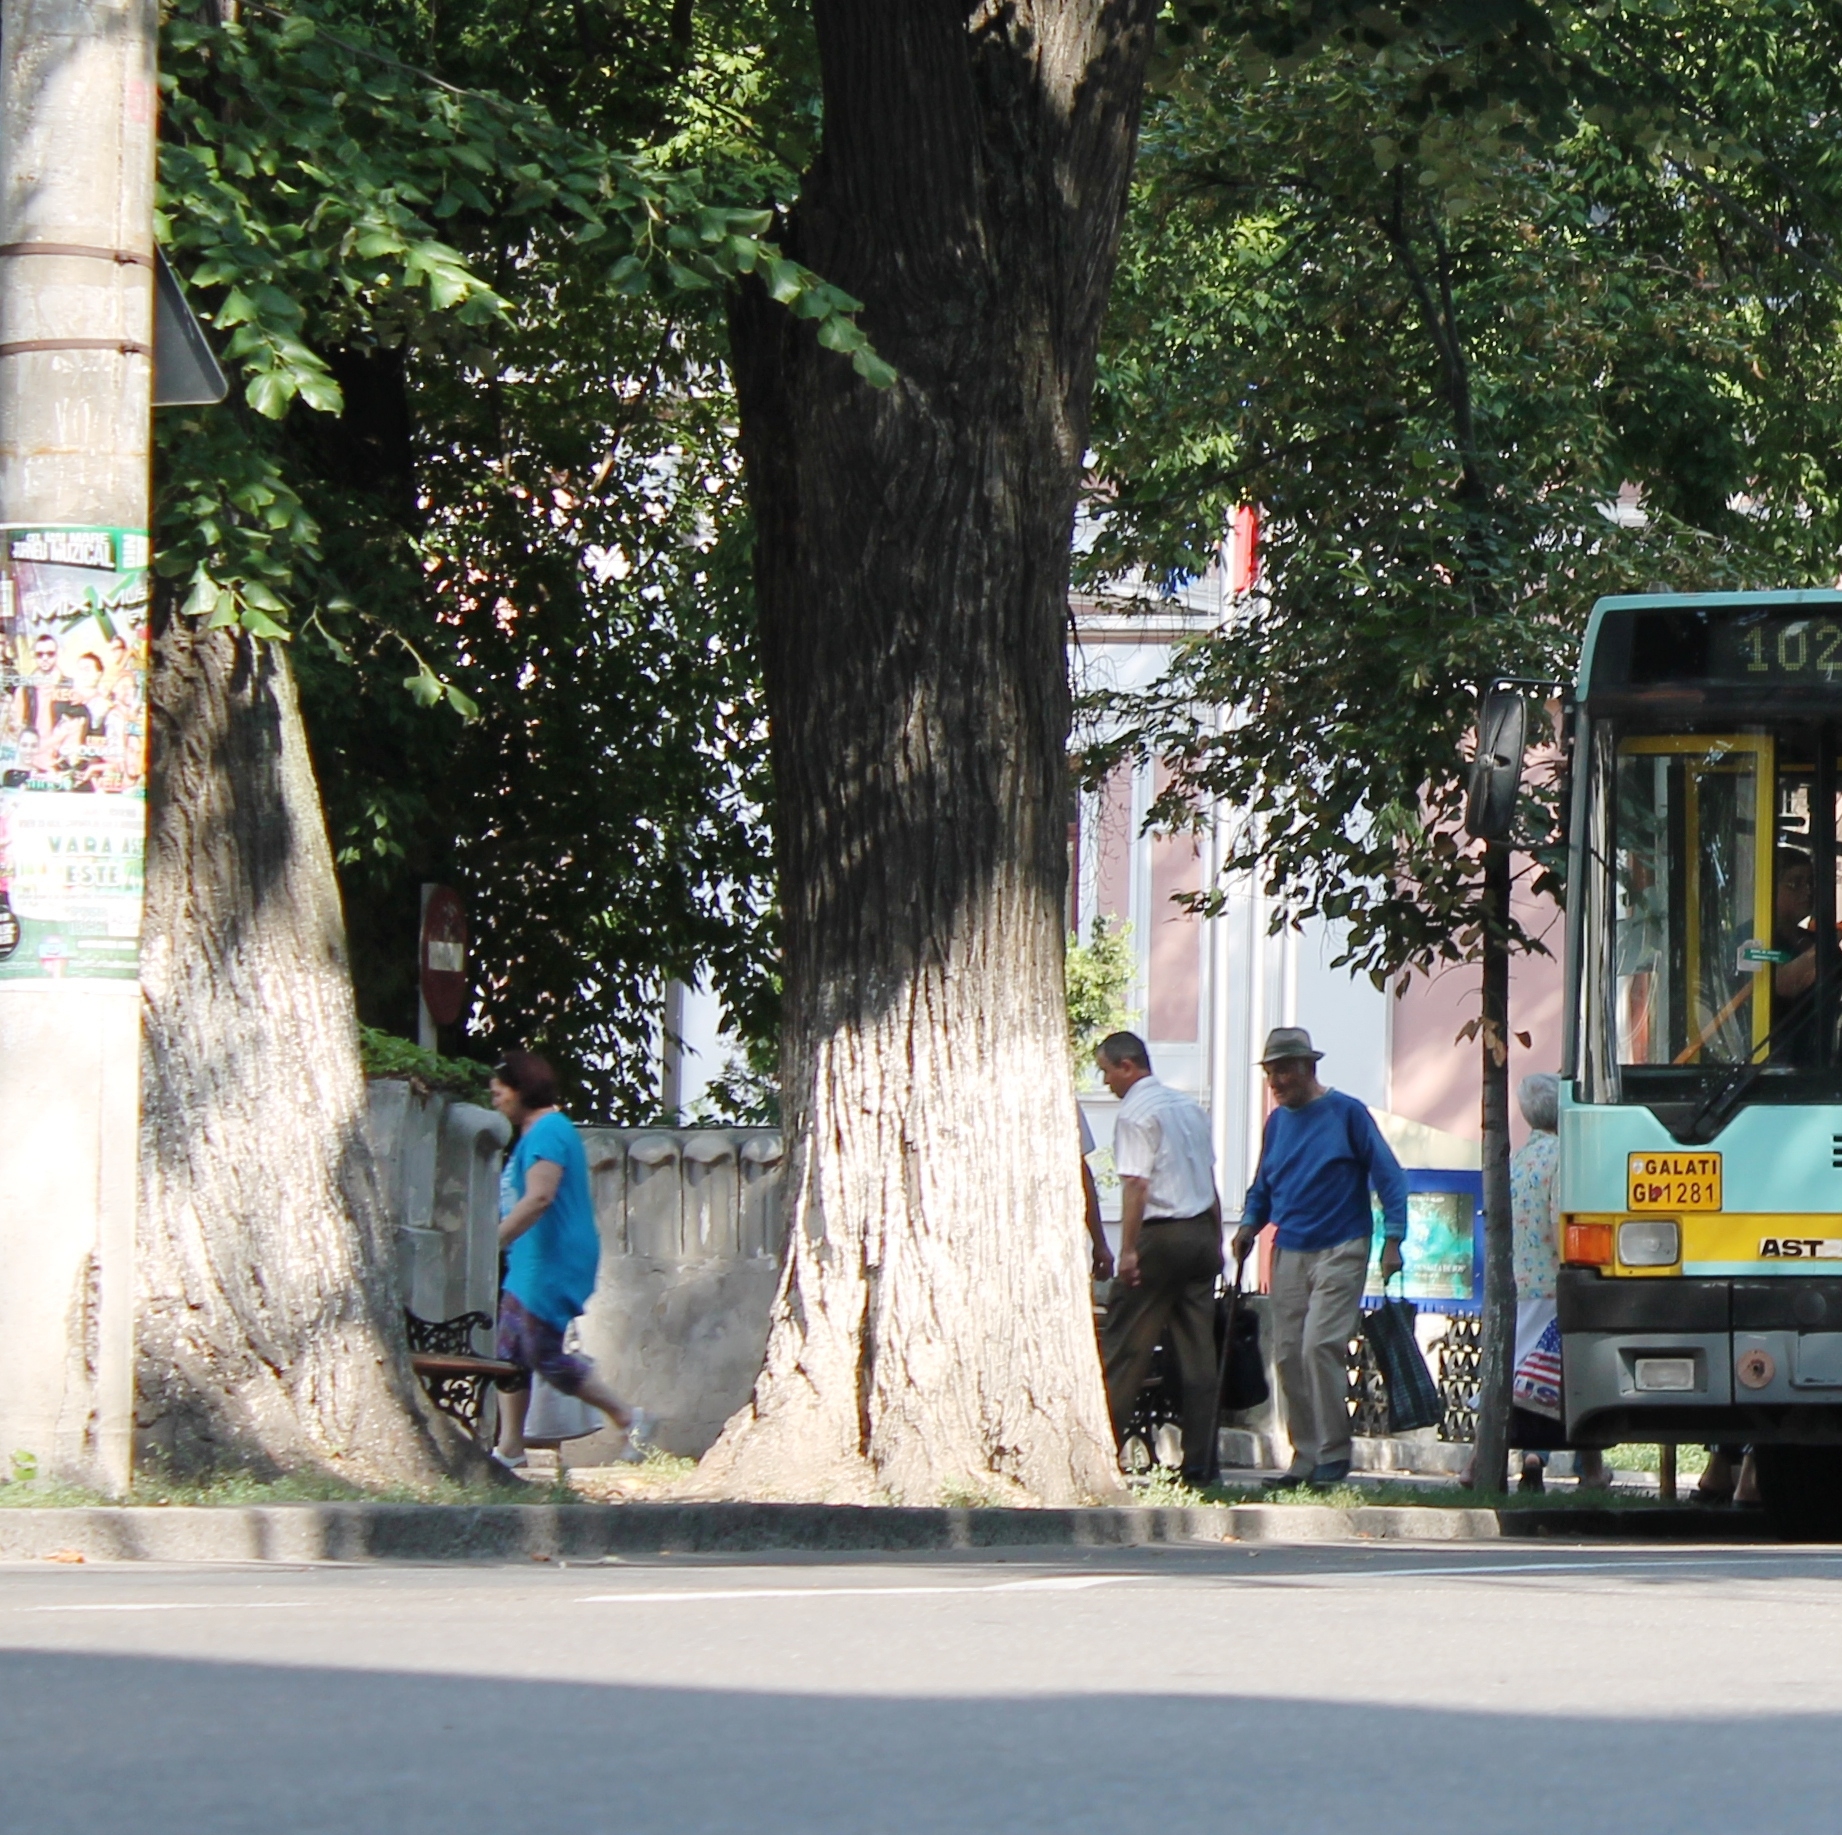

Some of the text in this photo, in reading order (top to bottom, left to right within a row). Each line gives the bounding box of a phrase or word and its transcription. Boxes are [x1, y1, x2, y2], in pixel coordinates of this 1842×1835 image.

[50, 540, 115, 569] MUZICAL
[48, 836, 112, 853] VARA
[66, 865, 117, 884] ESTE
[1645, 1159, 1717, 1176] GALATI
